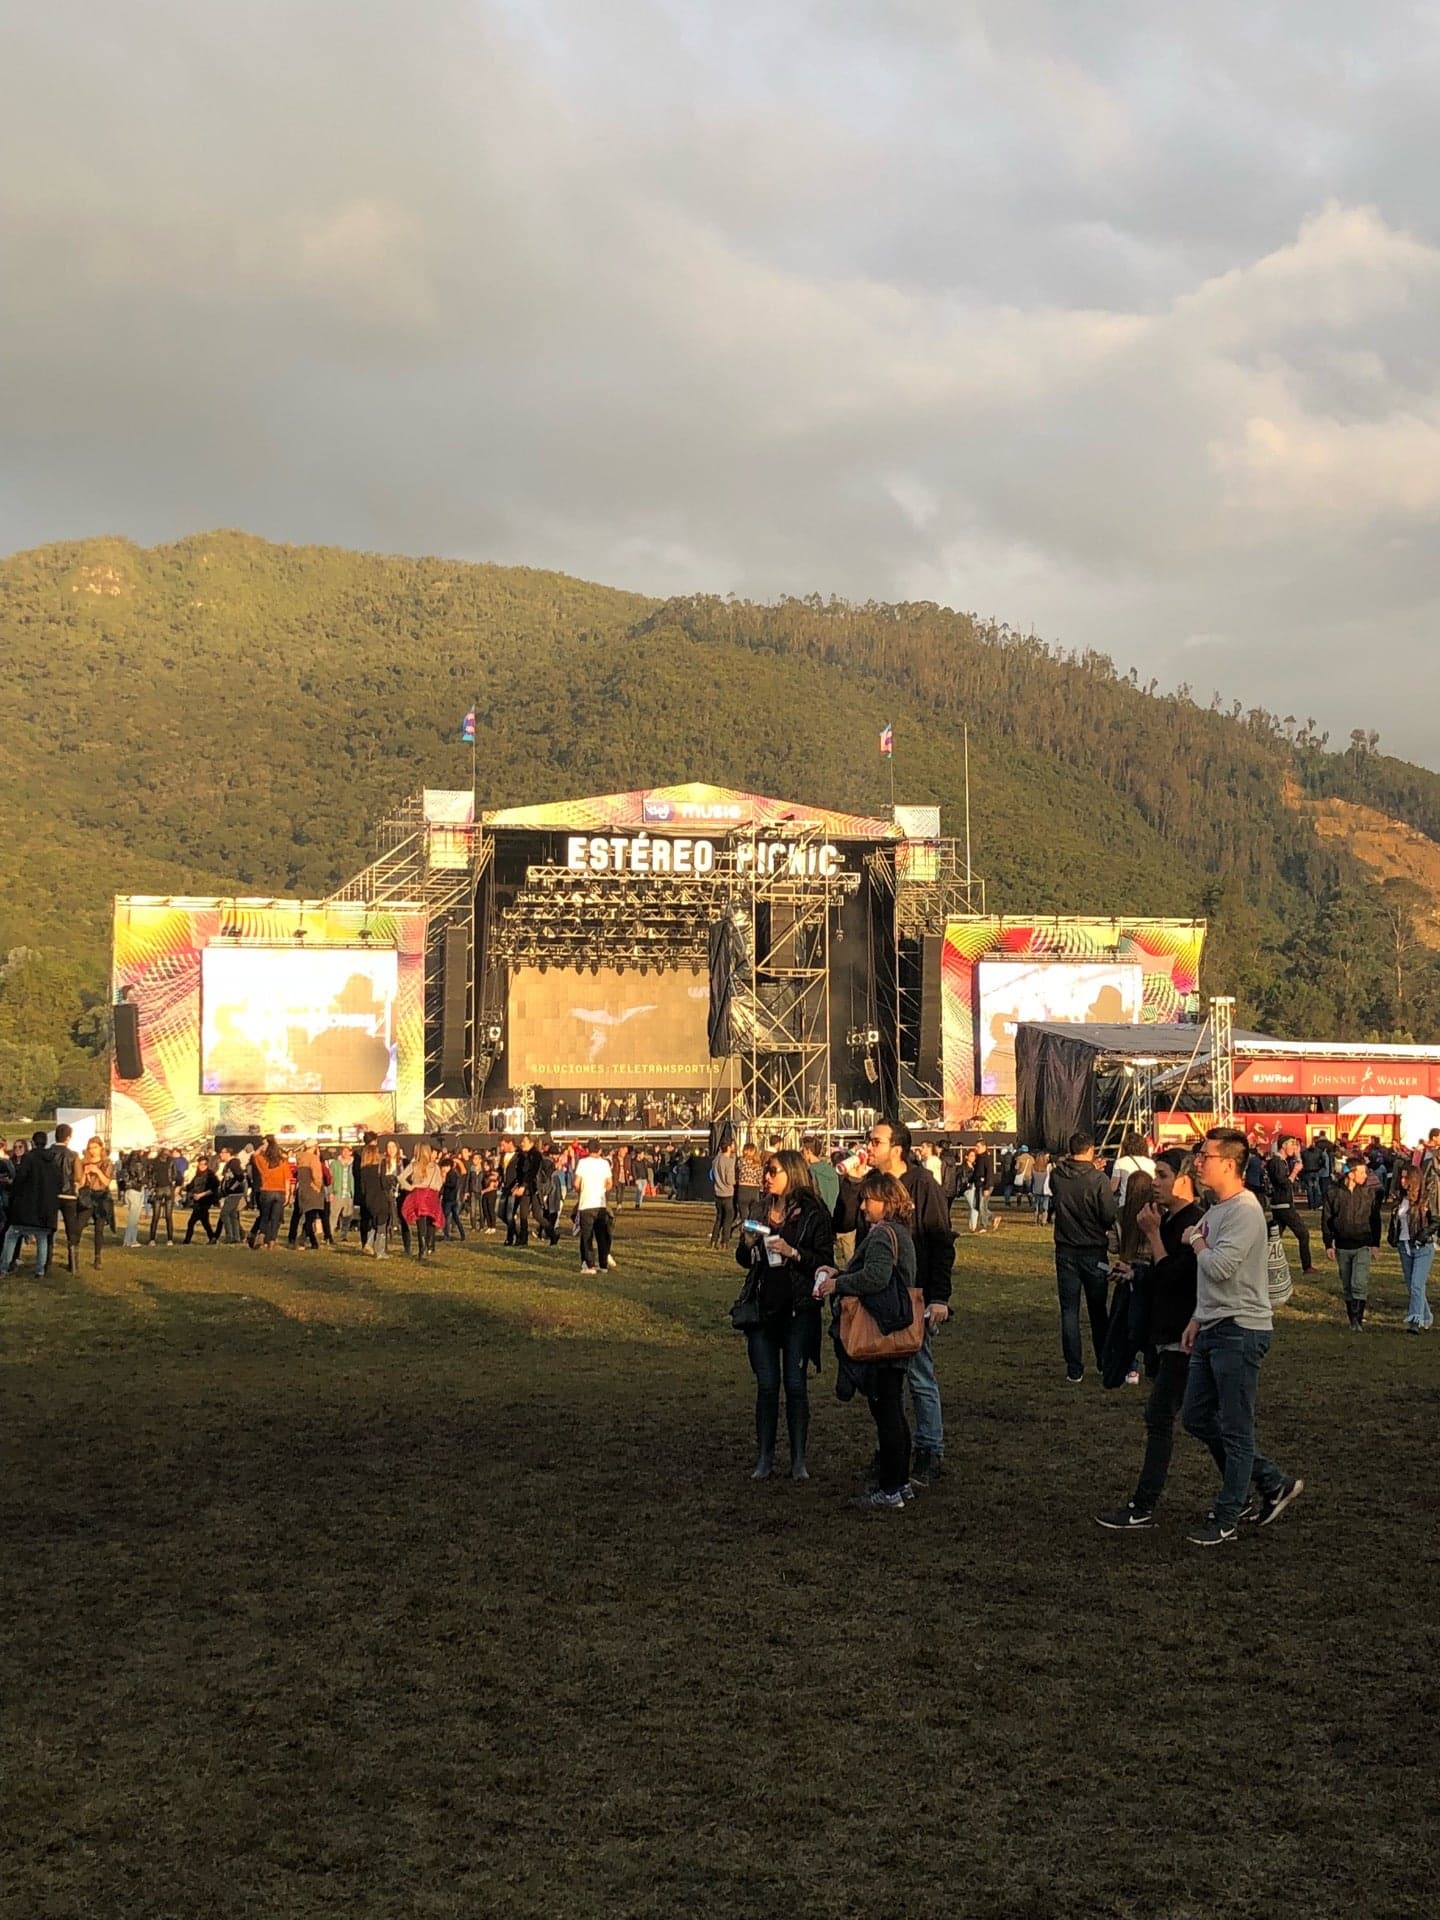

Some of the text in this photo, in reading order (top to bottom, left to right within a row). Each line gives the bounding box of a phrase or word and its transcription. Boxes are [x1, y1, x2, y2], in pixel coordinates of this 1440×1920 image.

[568, 832, 712, 872] ESTÉREO
[1253, 1074, 1294, 1084] #JWRed
[1377, 1075, 1417, 1086] WALKER
